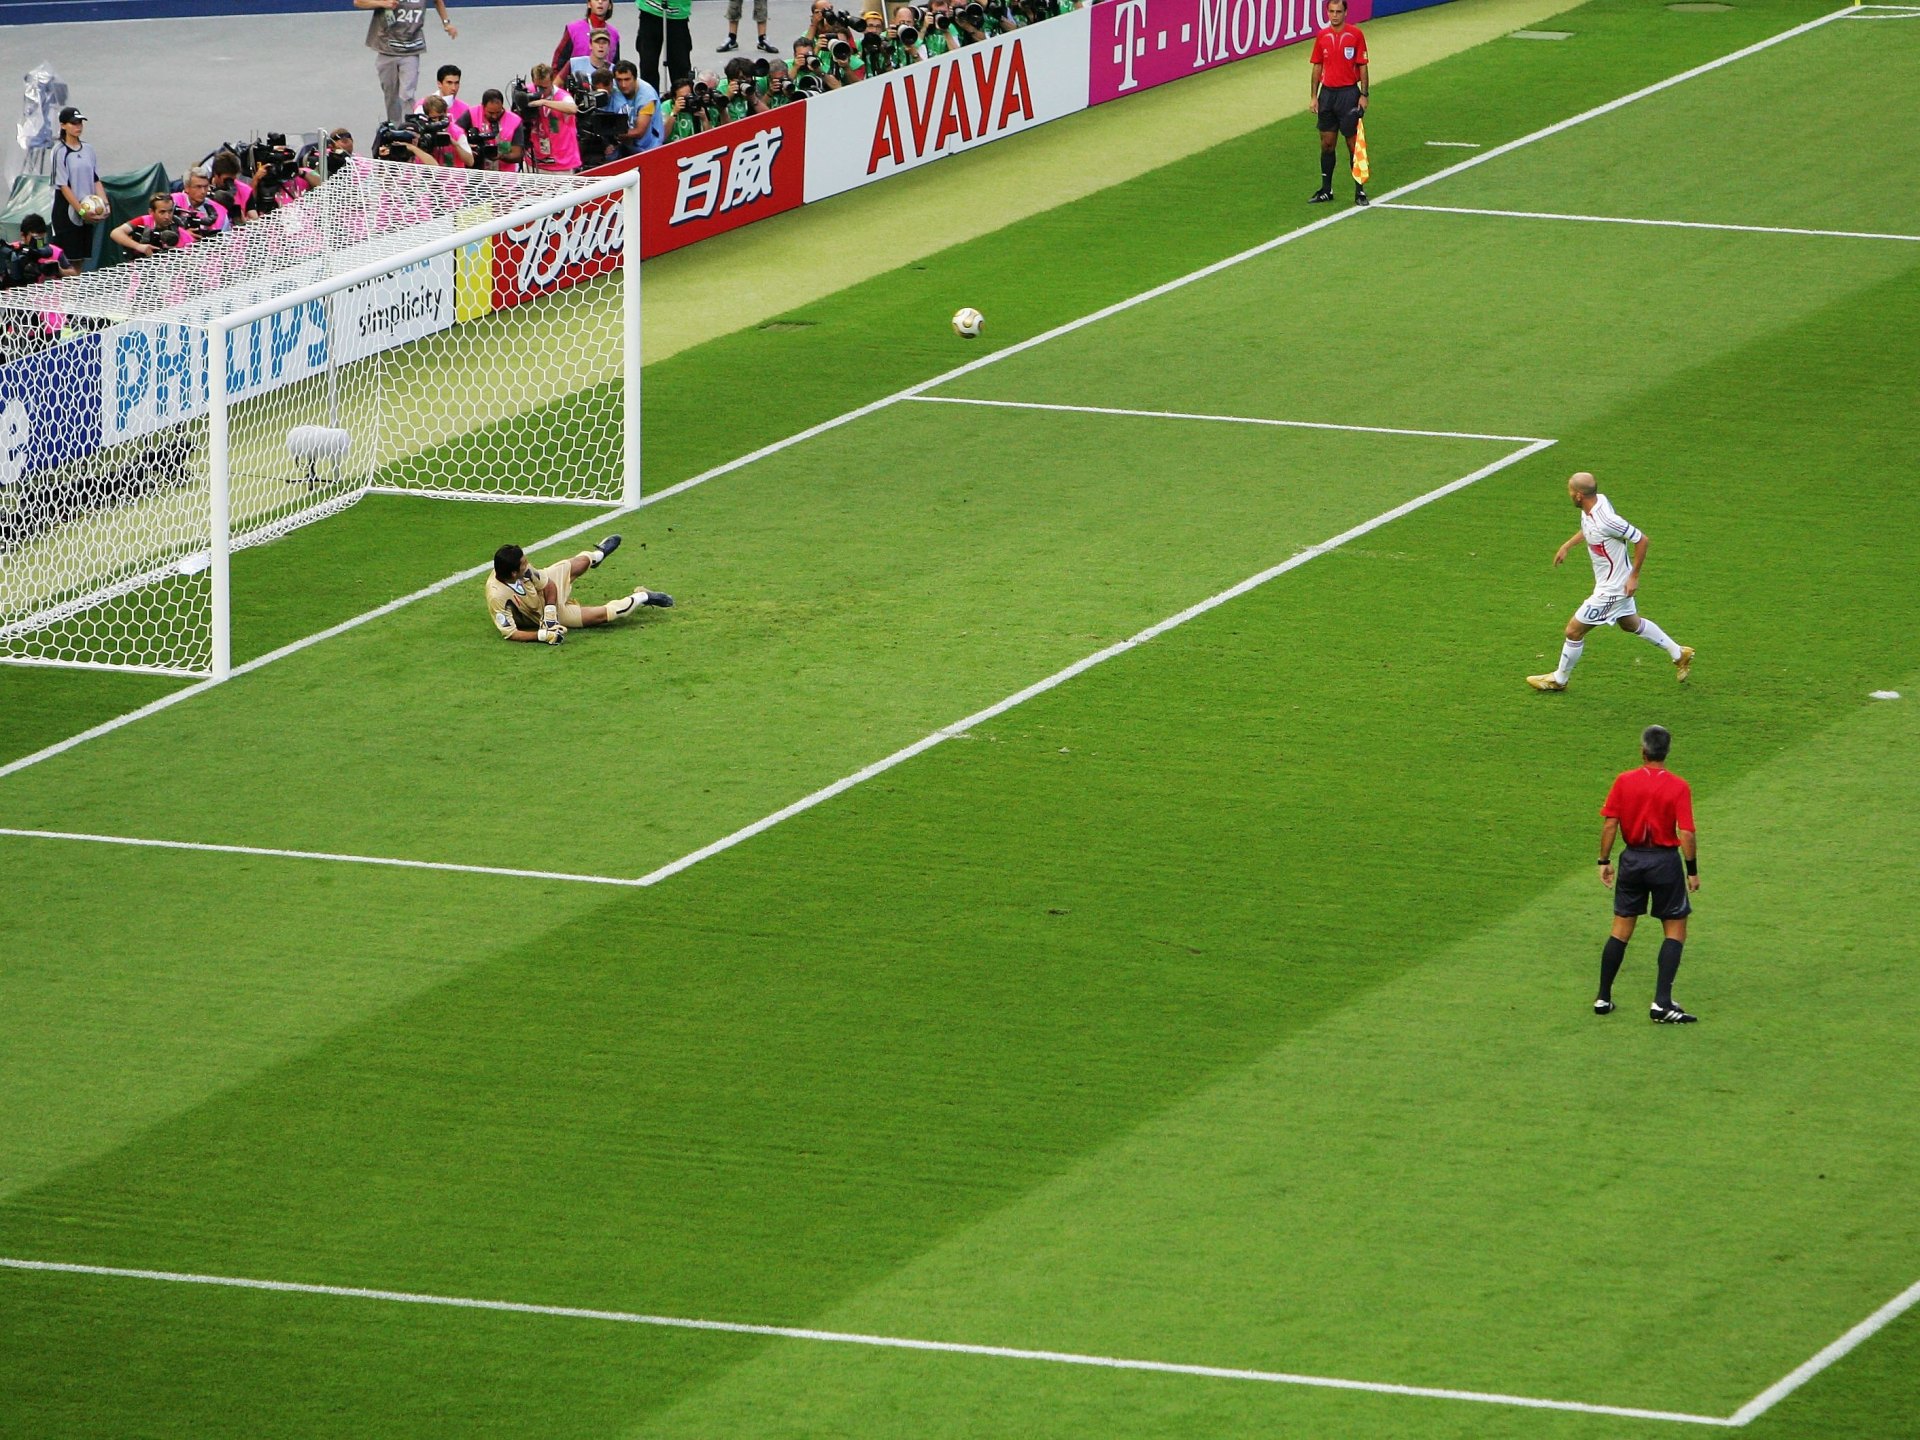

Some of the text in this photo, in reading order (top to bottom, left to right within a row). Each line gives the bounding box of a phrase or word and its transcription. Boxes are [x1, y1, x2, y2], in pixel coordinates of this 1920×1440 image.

[396, 8, 422, 23] 247
[867, 38, 1034, 175] AVAYA
[669, 126, 783, 227] 百威
[358, 284, 442, 337] simplicity
[114, 298, 328, 432] PHILIPS
[1583, 604, 1600, 620] 10
